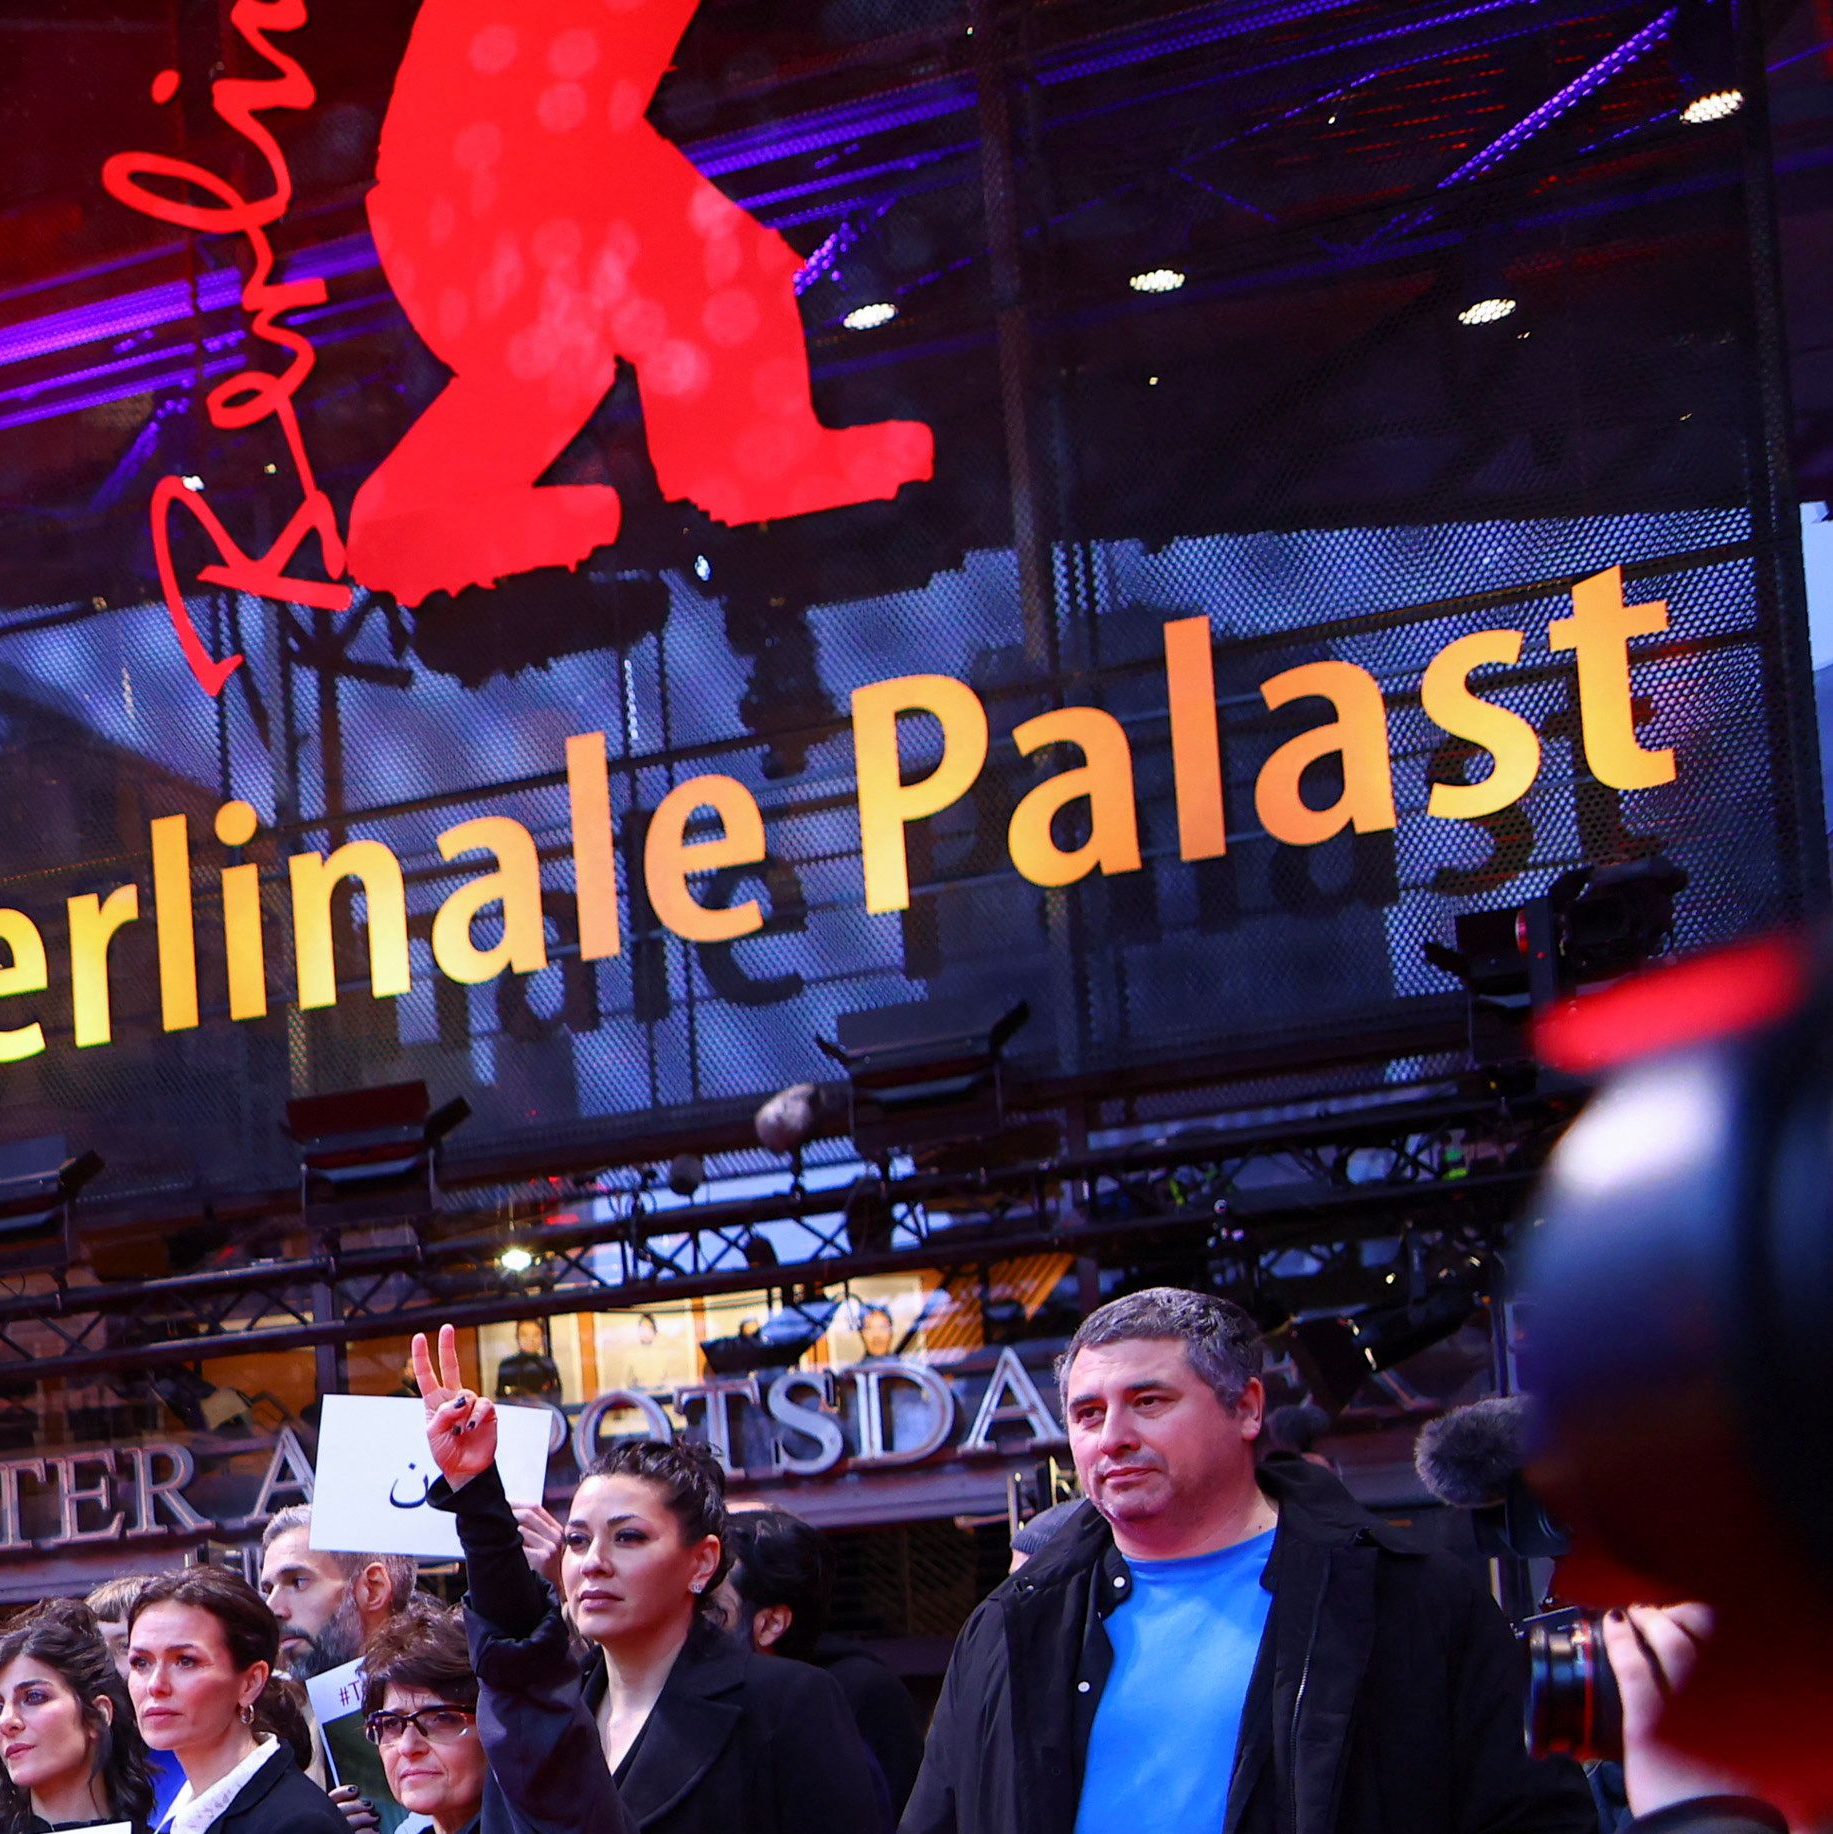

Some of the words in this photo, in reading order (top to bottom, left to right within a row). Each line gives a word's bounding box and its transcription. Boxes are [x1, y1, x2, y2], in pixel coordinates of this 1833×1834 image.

[848, 566, 1677, 914] Palast
[243, 1430, 317, 1524] A
[389, 1462, 429, 1509] ن
